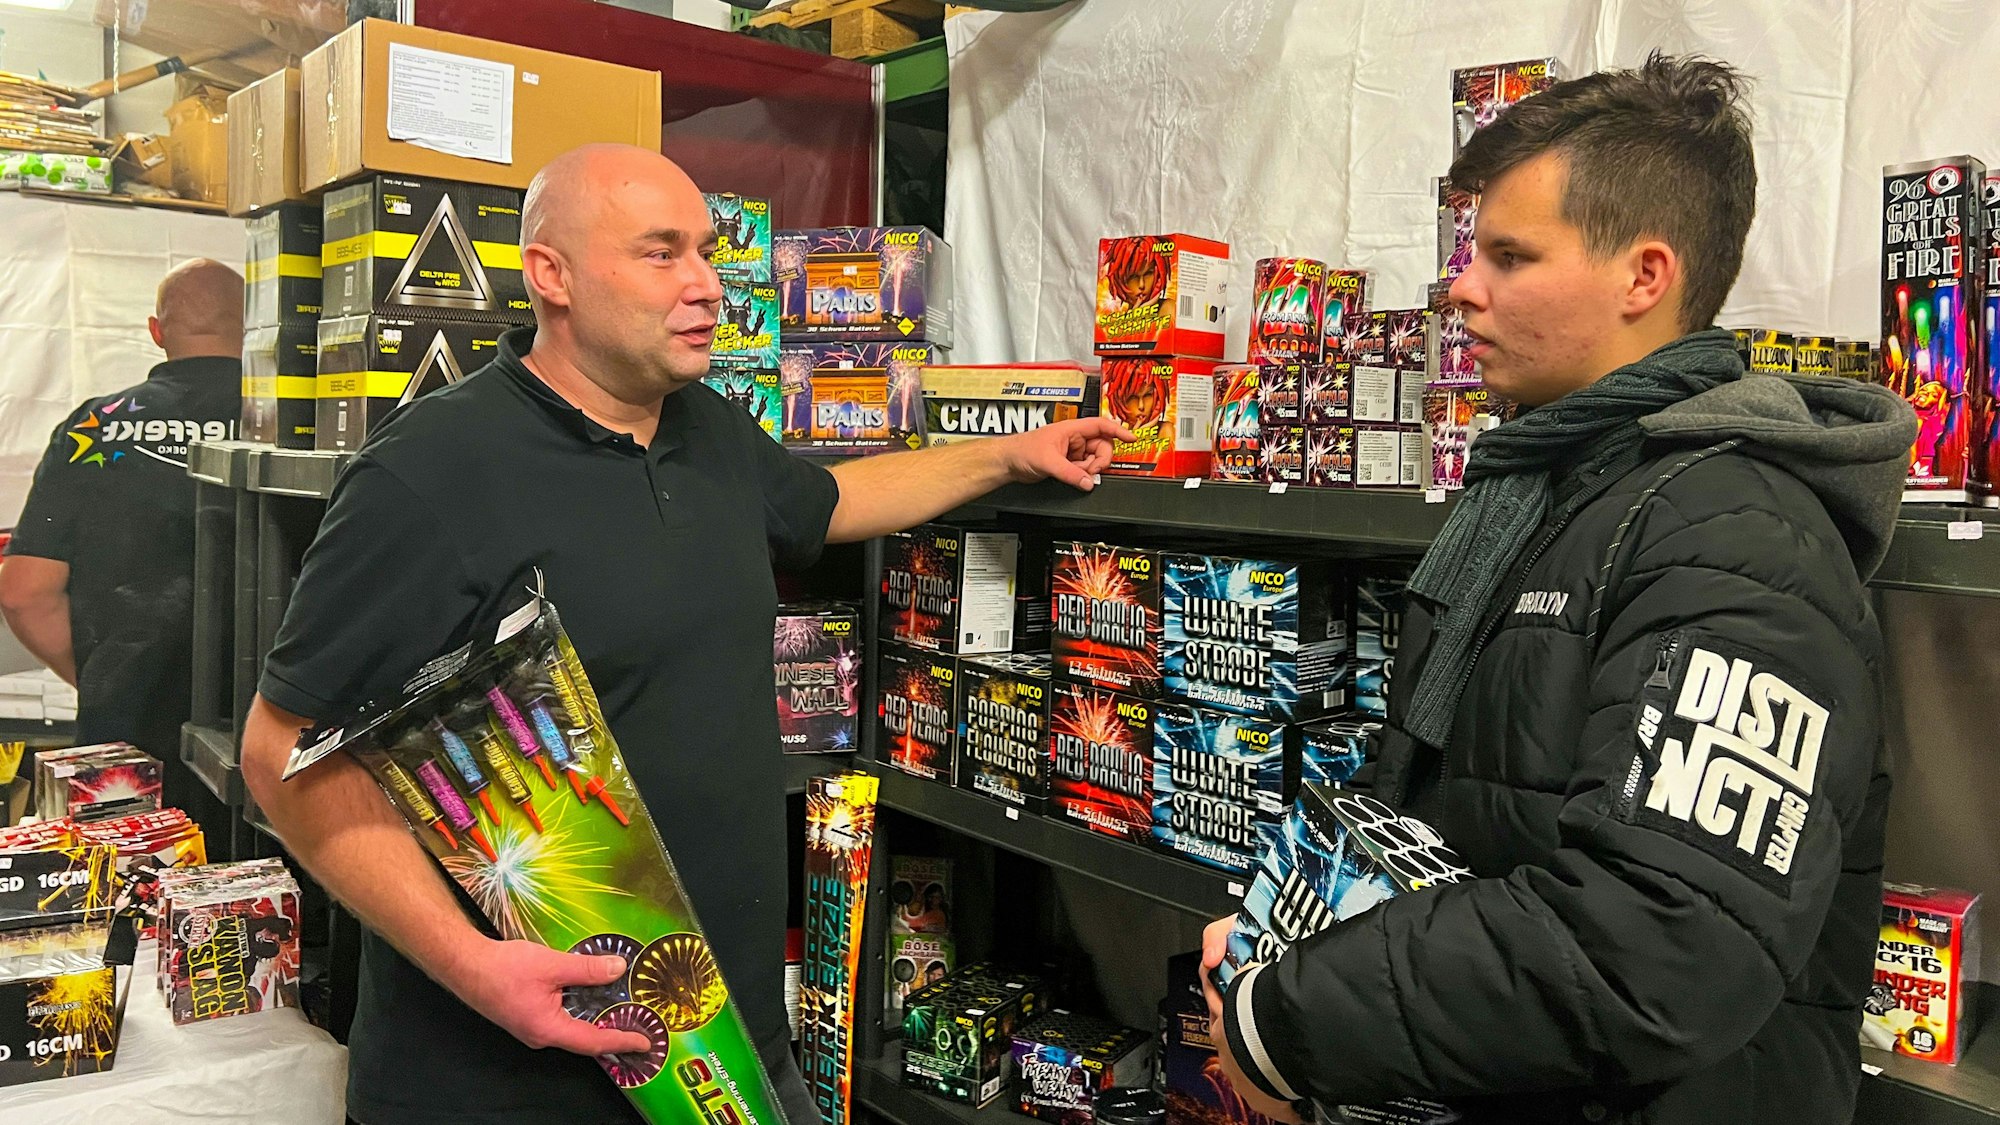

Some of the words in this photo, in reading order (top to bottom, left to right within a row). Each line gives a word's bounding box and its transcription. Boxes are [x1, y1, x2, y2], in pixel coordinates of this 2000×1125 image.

[1518, 66, 1546, 76] NICO
[1889, 176, 1927, 204] 96
[743, 201, 767, 211] NICO
[1886, 194, 1962, 224] GREAT
[884, 232, 920, 245] NICO
[1887, 216, 1962, 245] BALLS
[1152, 242, 1175, 253] NICO
[1294, 264, 1323, 276] NICO
[1887, 245, 1960, 281] FIRE
[419, 270, 443, 279] DELTA
[442, 279, 461, 287] NICO
[1327, 278, 1358, 288] NICO
[753, 288, 776, 298] NICO
[812, 289, 877, 314] PARIS
[892, 348, 928, 361] NICO
[1753, 346, 1791, 364] TITAN
[1151, 365, 1174, 375] NICO
[1336, 363, 1350, 371] NICO
[755, 374, 778, 384] NICO
[1466, 392, 1488, 400] NICO
[818, 403, 884, 428] PARIS
[940, 401, 1050, 434] CRANK
[935, 537, 957, 551] NICO
[1119, 557, 1150, 572] NICO
[1131, 572, 1149, 581] Europe
[1249, 571, 1285, 586] NICO
[889, 569, 911, 611] RED
[916, 573, 952, 616] TEARS
[1263, 585, 1283, 593] Europe
[823, 622, 851, 632] NICO
[1058, 593, 1086, 638] RED
[1091, 597, 1146, 648] DAHLIA
[1184, 596, 1273, 645] WHITE
[931, 665, 953, 681] NICO
[1086, 663, 1132, 681] Schuss
[1184, 640, 1272, 689] STROBE
[791, 687, 850, 713] WALL
[1017, 683, 1042, 700] NICO
[1208, 685, 1265, 705] Schuss
[885, 693, 907, 735] RED
[912, 700, 948, 746] TEARS
[967, 695, 1038, 743] POPPING
[1117, 702, 1148, 720] NICO
[1236, 727, 1269, 745] NICO
[966, 727, 1037, 778] FLOWERS
[1056, 733, 1084, 781] RED
[1090, 740, 1143, 797] DAHLIA
[1171, 746, 1258, 801] WHITE
[495, 764, 527, 800] LEMON
[988, 779, 1026, 800] Schuss
[1083, 805, 1129, 829] Schuss
[1172, 791, 1257, 847] STROBE
[1764, 791, 1810, 876] CHAPTER
[1194, 839, 1250, 864] Schuss
[37, 870, 90, 889] 16CM
[904, 938, 940, 951] BÖSE
[1879, 940, 1934, 956] NDER
[211, 915, 249, 1014] KANON
[1908, 956, 1942, 974] 16
[187, 943, 222, 1019] SLAG
[26, 1034, 83, 1057] 16CM
[1913, 1030, 1933, 1046] 16
[906, 1064, 922, 1075] 25
[707, 1051, 760, 1125] ernenring-Effekt
